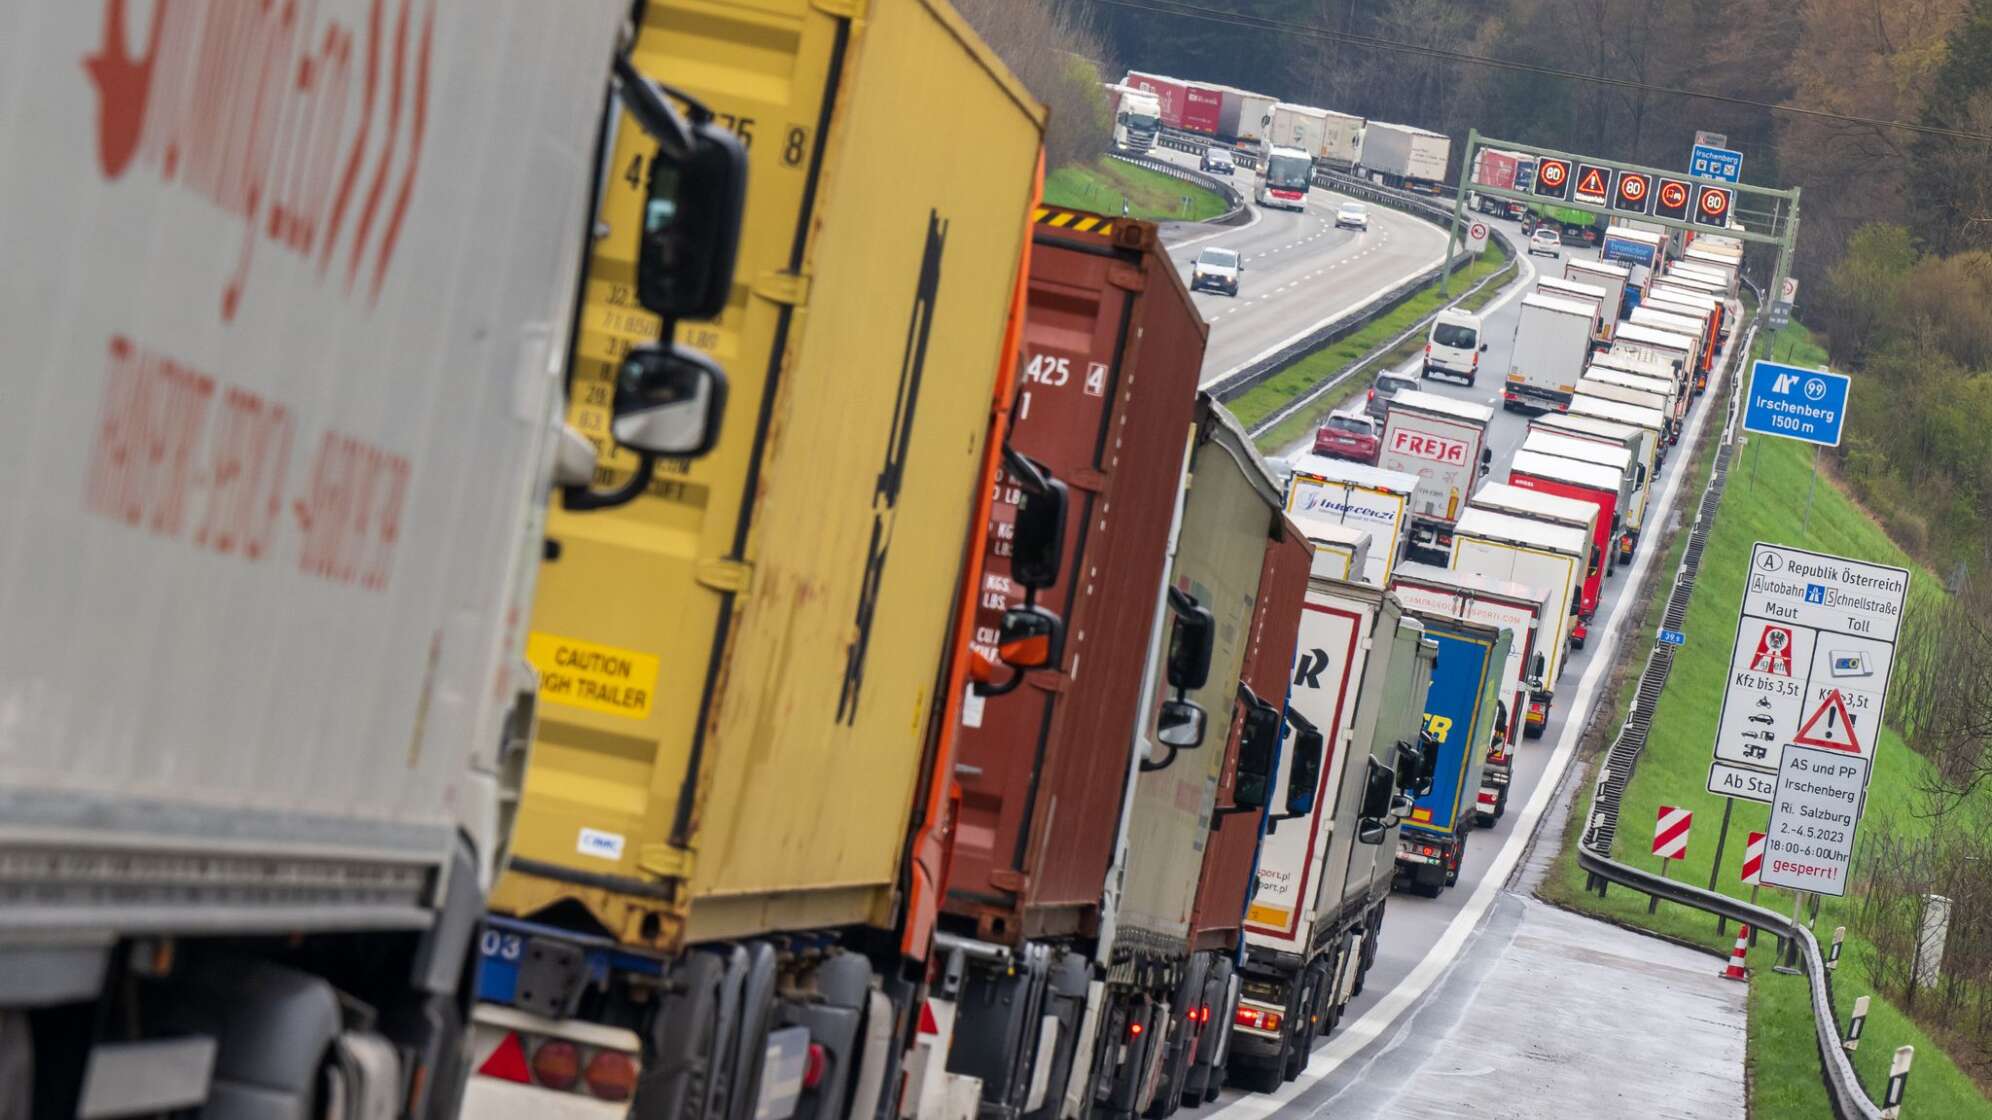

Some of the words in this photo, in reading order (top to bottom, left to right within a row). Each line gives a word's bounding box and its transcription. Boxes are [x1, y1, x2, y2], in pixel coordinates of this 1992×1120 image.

[783, 126, 806, 168] 8
[1546, 166, 1560, 181] 80
[1625, 181, 1640, 196] 80
[1707, 195, 1722, 210] 80
[1807, 382, 1824, 396] 99
[1756, 395, 1835, 424] Irschenberg
[1771, 414, 1800, 430] 1500
[1802, 423, 1814, 433] m
[1395, 432, 1464, 460] FREJA
[1763, 554, 1774, 569] A
[1788, 560, 1838, 581] Republik
[1842, 567, 1902, 593] Österreich
[1753, 576, 1805, 598] Autobahn
[1827, 589, 1898, 616] Schnellstraße
[1765, 601, 1799, 620] Maut
[1848, 617, 1870, 633] Toll
[554, 645, 632, 680] CAUTION
[577, 678, 648, 711] TRAILER
[1736, 672, 1754, 688] Kfz
[1757, 677, 1774, 691] bis
[1777, 682, 1800, 697] 3,5t
[1790, 757, 1808, 771] AS
[1812, 764, 1836, 776] und
[1839, 766, 1857, 779] PP
[1723, 772, 1743, 789] Ab
[1747, 776, 1776, 795] Sta
[1785, 778, 1855, 803] Irschenberg
[1780, 801, 1795, 815] Ri.
[1800, 805, 1851, 827] Salzburg
[1780, 822, 1844, 843] 2.-4.5.2023
[1773, 859, 1838, 881] gesperrt!
